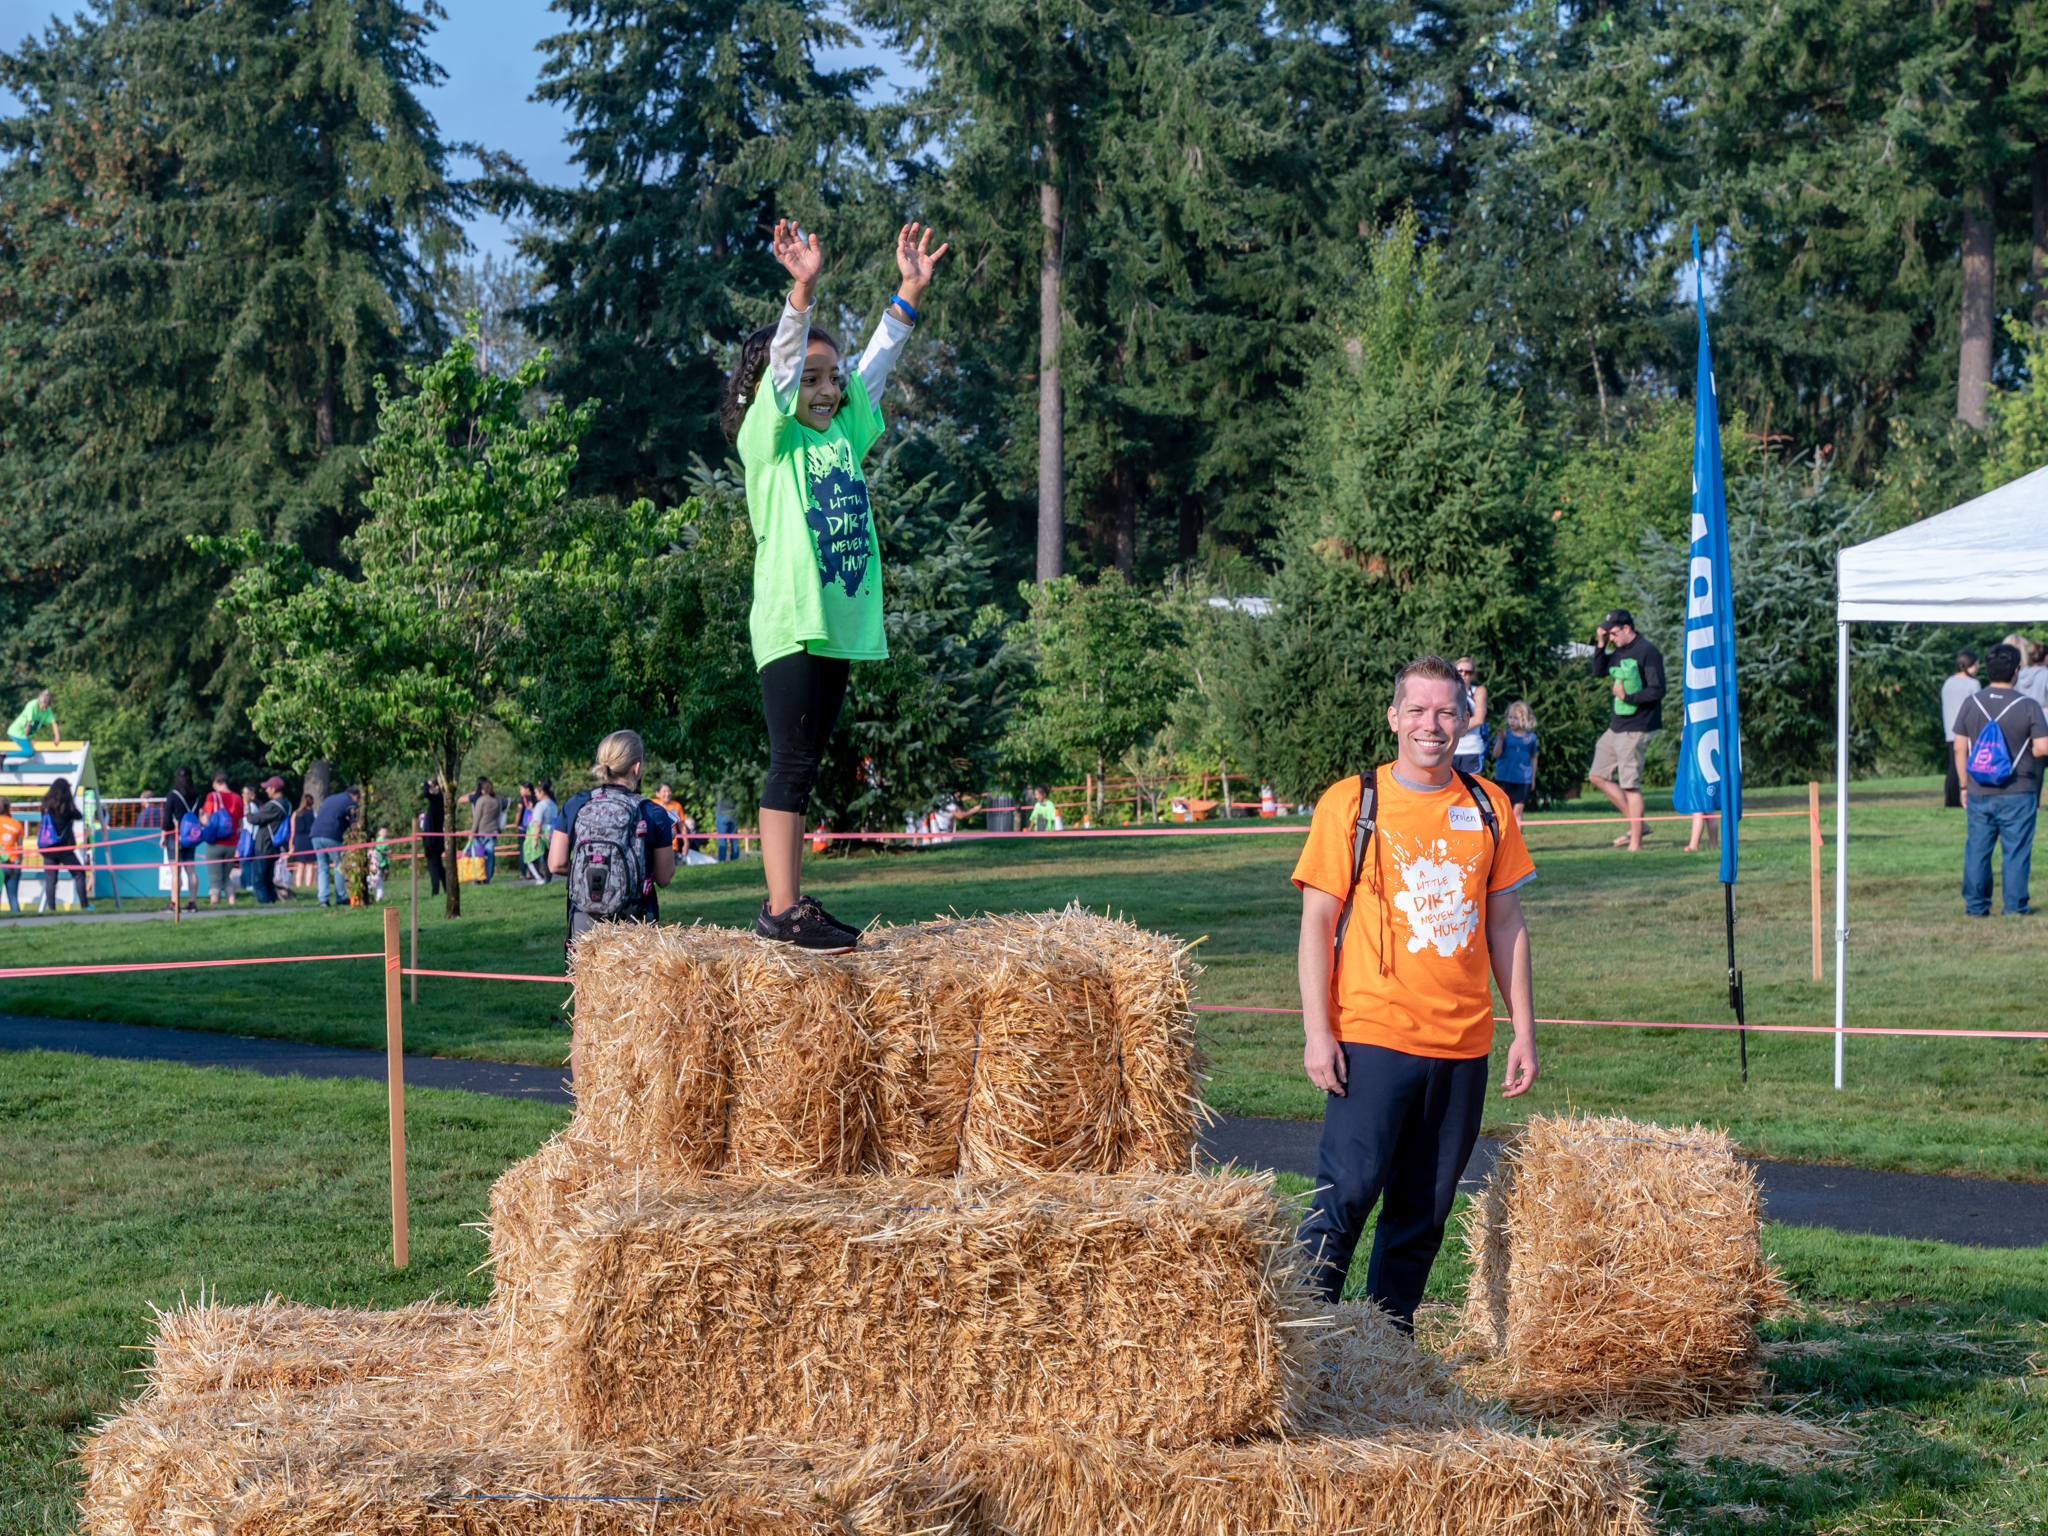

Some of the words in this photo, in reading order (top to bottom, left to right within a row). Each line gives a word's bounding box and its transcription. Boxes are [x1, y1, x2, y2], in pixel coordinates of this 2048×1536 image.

[834, 483, 842, 495] A
[829, 494, 863, 510] LITTL
[826, 512, 867, 536] DIRT
[1419, 870, 1426, 879] A
[1416, 876, 1448, 891] LITTLE
[1413, 889, 1457, 912] DIRT
[1421, 910, 1454, 925] NEVER
[1433, 920, 1468, 938] HURT
